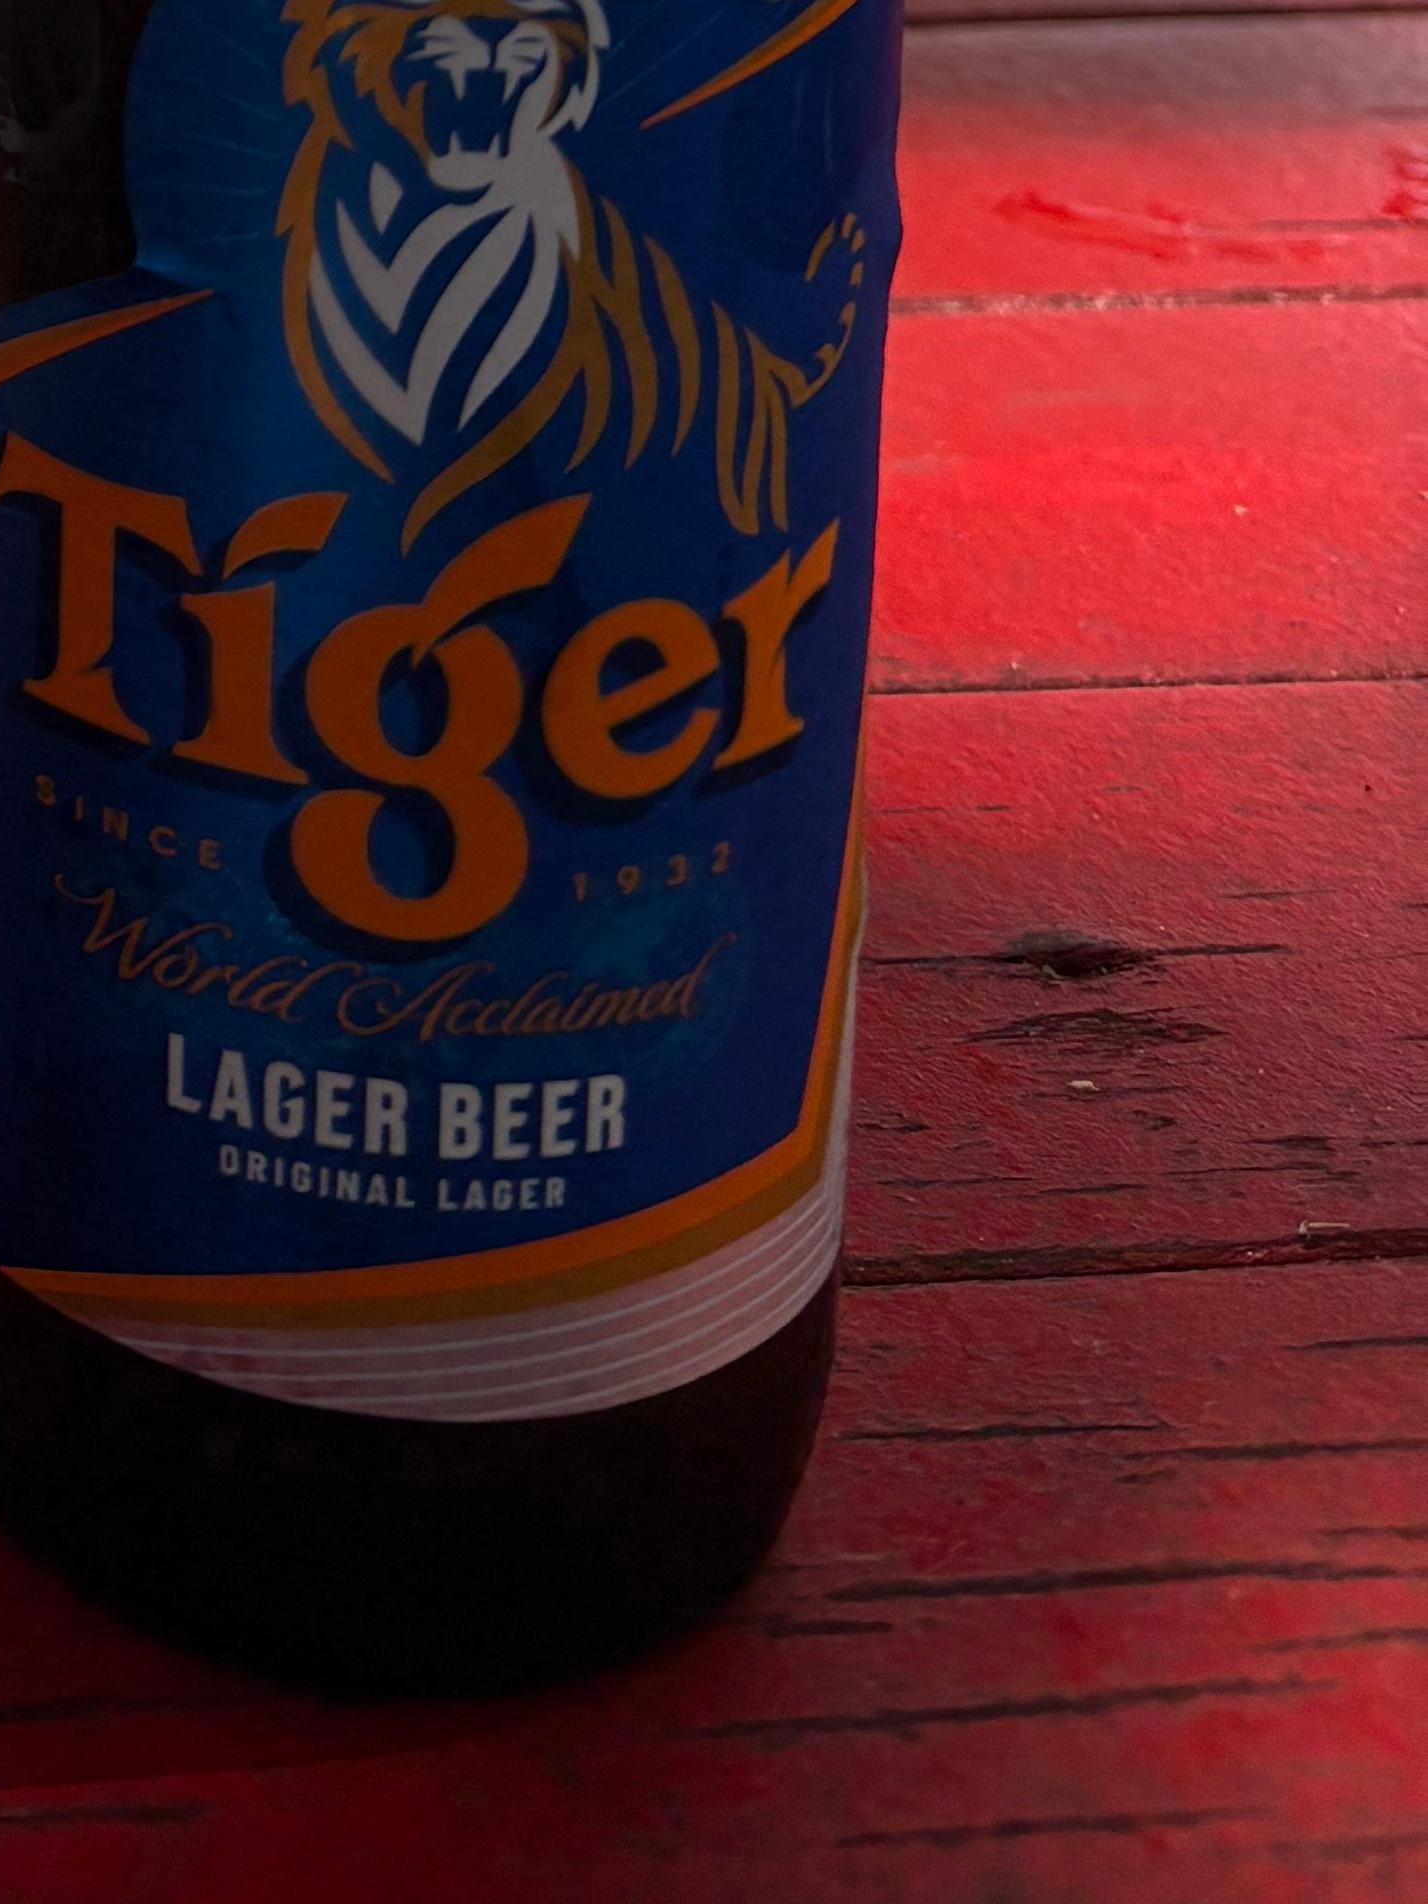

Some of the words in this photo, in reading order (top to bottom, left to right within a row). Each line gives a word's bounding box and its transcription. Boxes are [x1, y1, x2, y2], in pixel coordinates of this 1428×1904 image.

[34, 773, 223, 871] SINCE
[572, 840, 732, 902] 1932
[53, 872, 363, 1023] World
[337, 930, 738, 1043] Acclaimed
[166, 1032, 409, 1157] LAGER
[439, 1073, 626, 1161] BEER
[220, 1143, 416, 1209] ORIGINAL
[437, 1176, 567, 1212] LAGER
